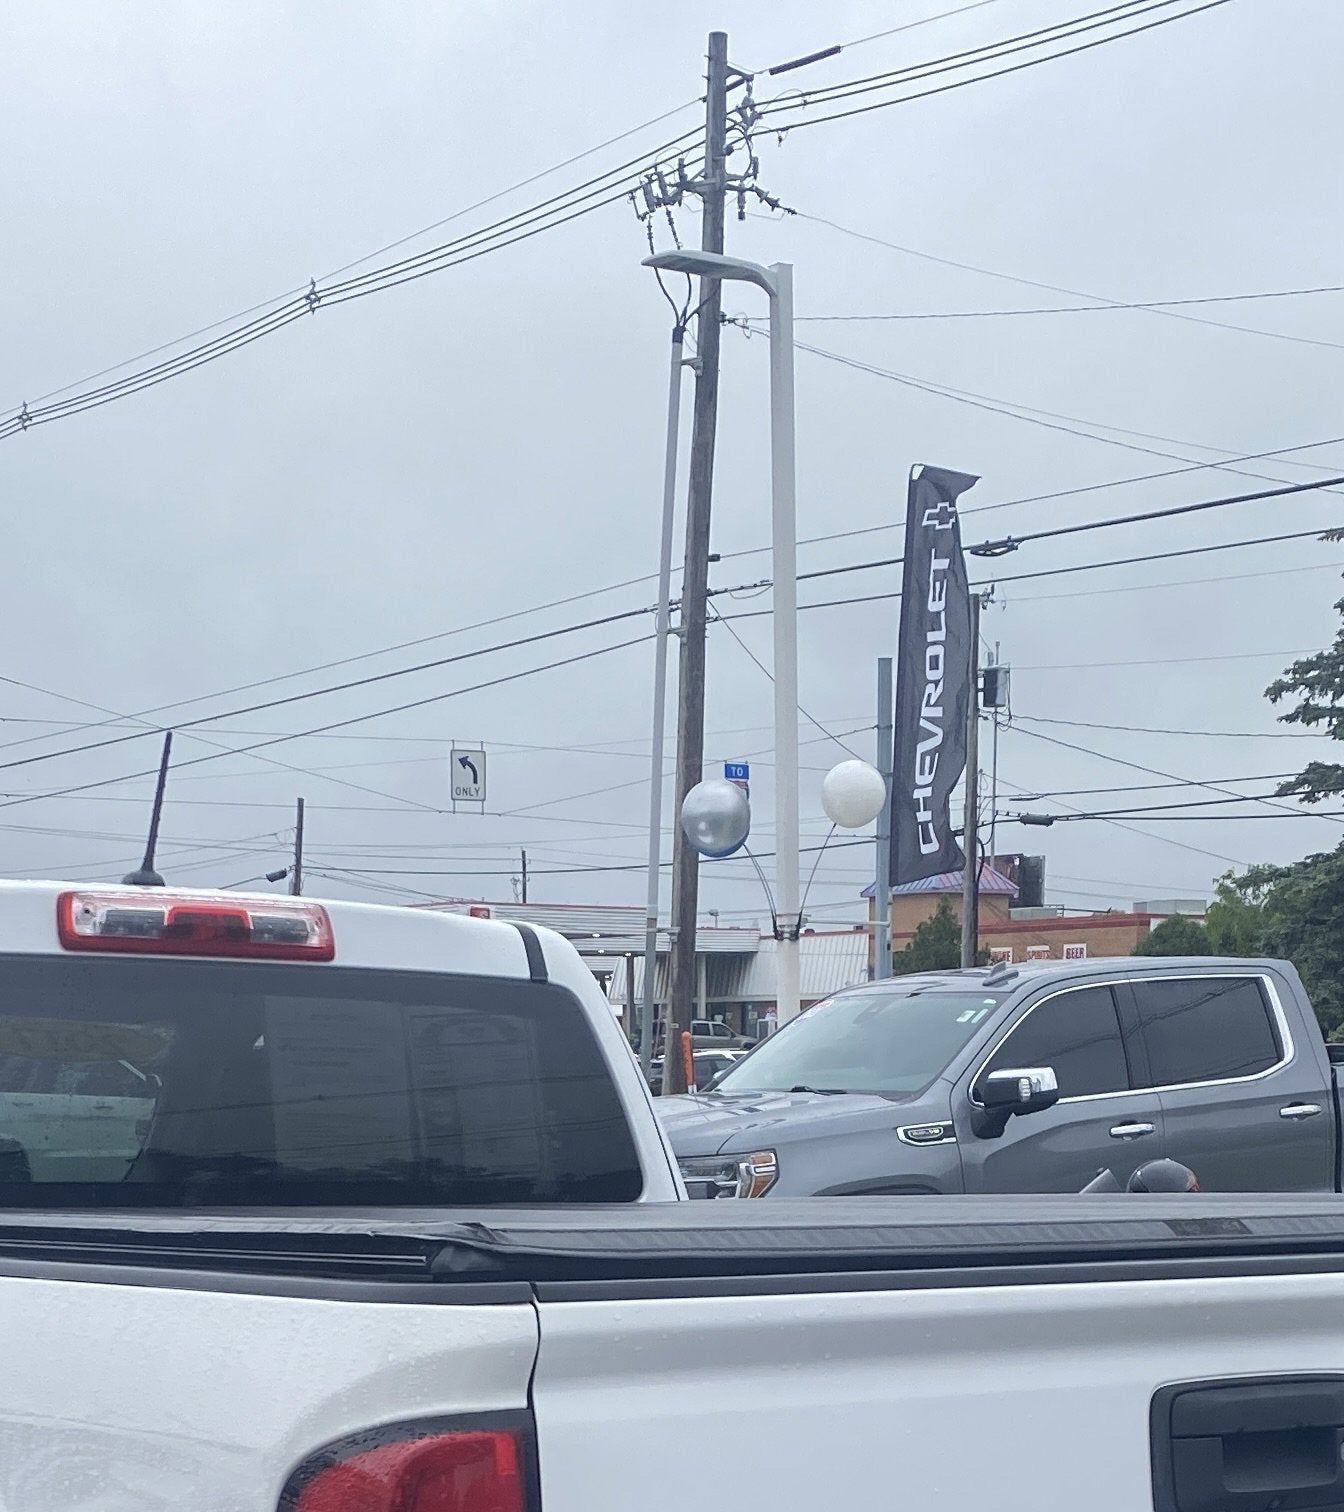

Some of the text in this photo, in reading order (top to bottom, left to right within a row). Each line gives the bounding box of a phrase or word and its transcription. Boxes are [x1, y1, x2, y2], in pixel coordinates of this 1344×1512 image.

[912, 547, 950, 855] CHEVROLET
[731, 767, 744, 777] TO
[455, 786, 481, 797] ONLY
[1065, 947, 1085, 960] BEER
